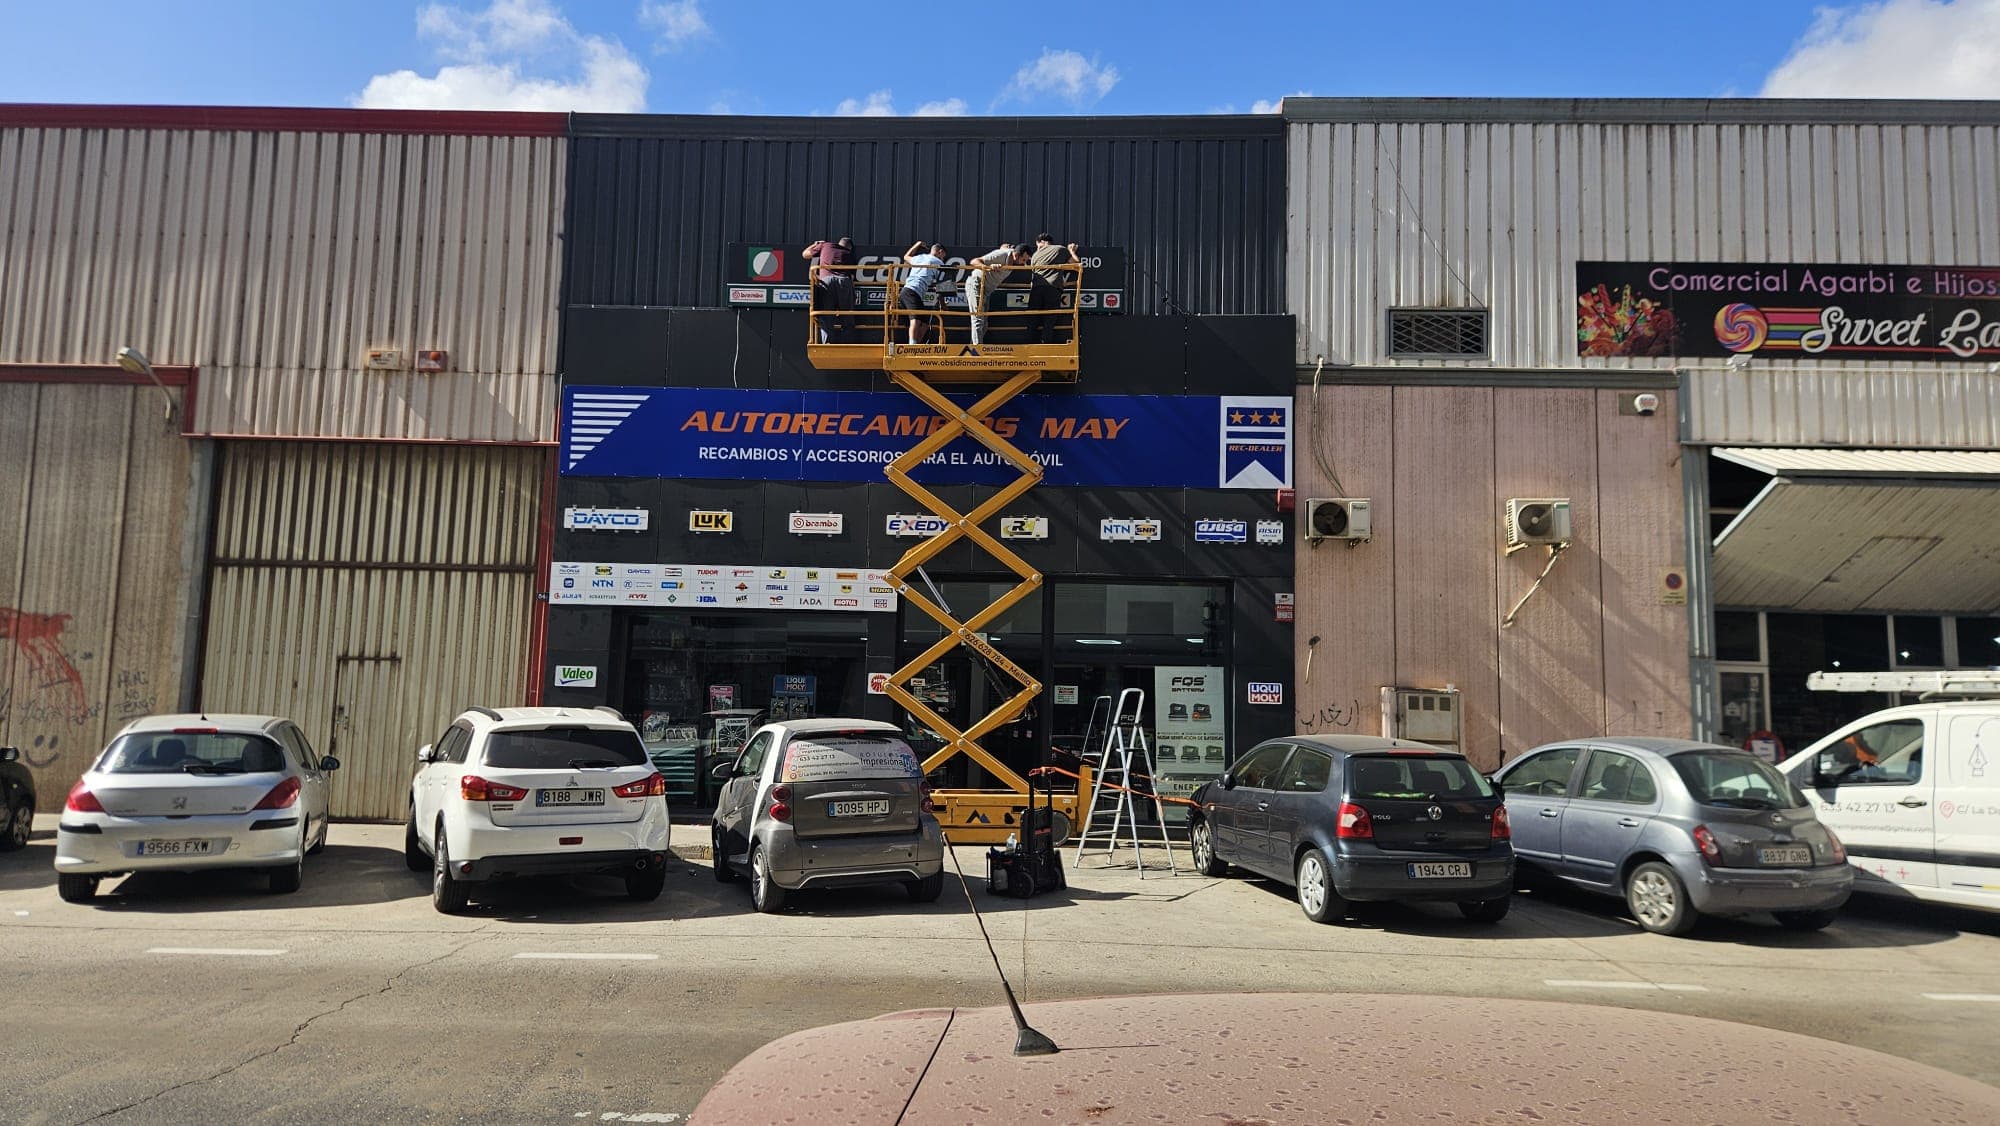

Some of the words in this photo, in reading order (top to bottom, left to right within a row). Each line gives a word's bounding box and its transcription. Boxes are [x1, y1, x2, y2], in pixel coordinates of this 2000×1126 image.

[1648, 267, 1789, 293] Comercial
[1800, 268, 1895, 297] Agarbi
[1906, 276, 1922, 295] e
[1934, 270, 1999, 298] Hijos
[778, 292, 812, 301] DAYC
[1801, 306, 1927, 354] Sweet
[896, 344, 932, 356] Compact
[919, 357, 1047, 367] www.obsidianamediterranea.com
[680, 410, 1021, 439] AUTORECAMBS
[1039, 416, 1131, 440] MAY
[1228, 444, 1284, 452] REC-DEALER
[699, 446, 788, 461] RECAMBIOS
[792, 448, 802, 461] Y
[806, 449, 905, 463] ACCESORIOS
[950, 452, 968, 465] EL
[972, 450, 1064, 467] AUTÓVIL
[573, 512, 640, 526] DAYCO
[805, 519, 838, 528] brembo
[888, 519, 950, 532] EXEDY
[1103, 524, 1131, 534] NTN
[1136, 526, 1156, 534] SNR
[592, 579, 614, 588] NTN
[835, 599, 857, 607] MOTUL
[978, 642, 992, 656] 628
[562, 667, 594, 680] Valeo
[784, 683, 806, 691] MOLY
[1171, 676, 1205, 687] FQS
[1251, 684, 1280, 693] LIQUI
[1251, 693, 1281, 702] MOLY
[543, 791, 571, 803] 8188
[580, 790, 602, 802] JWR
[837, 802, 864, 814] 3095
[867, 800, 887, 813] HPJ
[1846, 803, 1862, 812] 42
[1865, 803, 1879, 813] 27
[147, 842, 180, 854] 9566
[184, 841, 209, 853] FXW
[1418, 865, 1445, 877] 1943
[1447, 864, 1469, 876] CRJ
